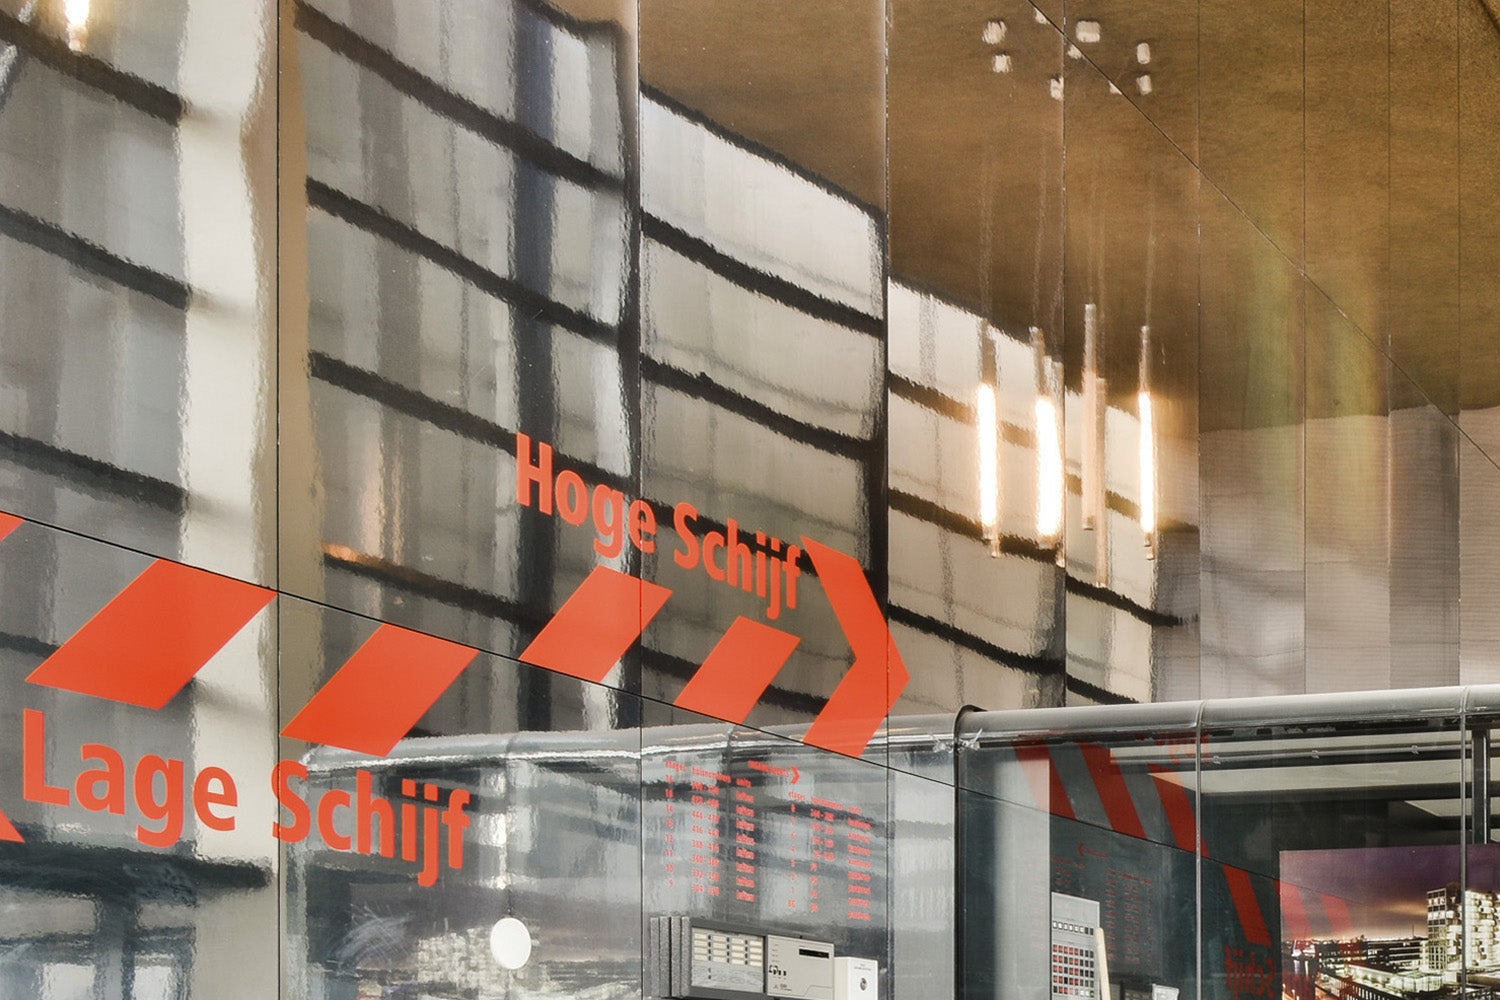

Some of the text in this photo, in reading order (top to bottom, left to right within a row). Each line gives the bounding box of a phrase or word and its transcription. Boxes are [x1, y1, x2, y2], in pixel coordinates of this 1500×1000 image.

[516, 431, 801, 620] Hoge Schijf
[23, 708, 471, 887] Lage Schijf
